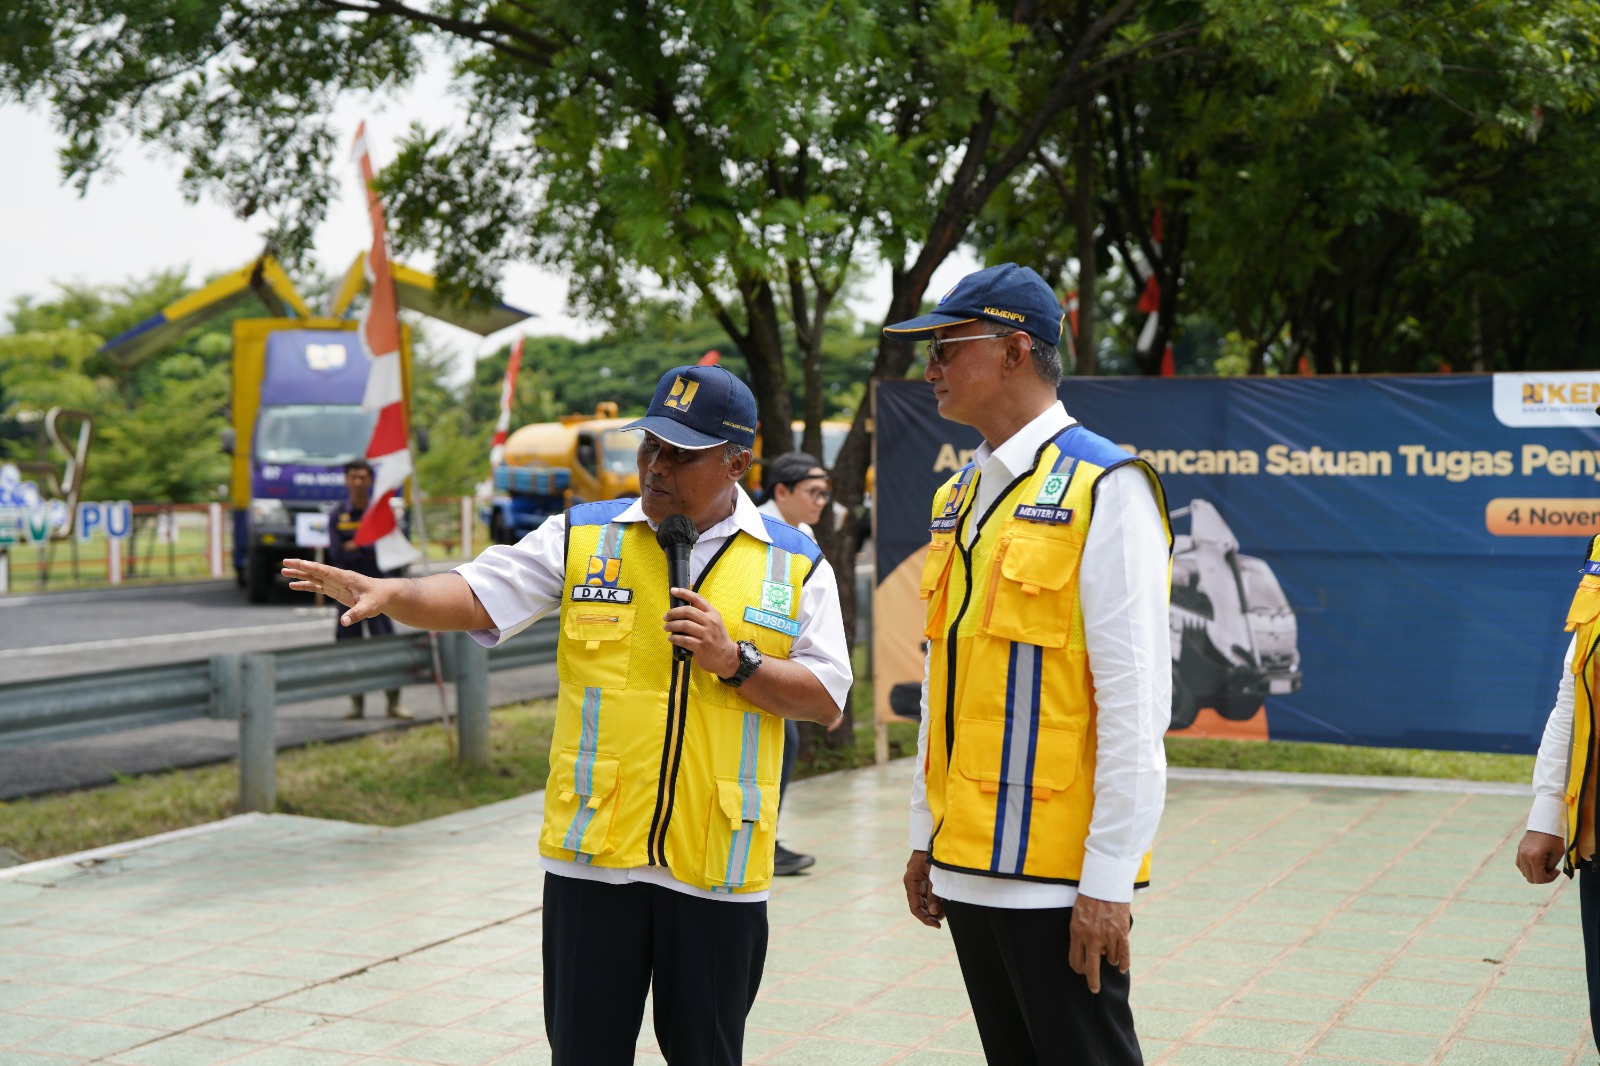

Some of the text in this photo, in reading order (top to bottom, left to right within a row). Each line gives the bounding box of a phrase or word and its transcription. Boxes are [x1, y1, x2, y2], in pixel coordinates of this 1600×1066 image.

[984, 306, 1025, 323] KEMENPU
[1117, 444, 1259, 475] encana
[1265, 444, 1392, 476] Satuan
[1398, 444, 1514, 482] Tugas
[82, 504, 130, 538] PU
[1018, 506, 1068, 520] MENTERI PU
[1506, 506, 1521, 526] 4
[581, 587, 619, 600] DAK
[755, 612, 791, 631] DJSDA
